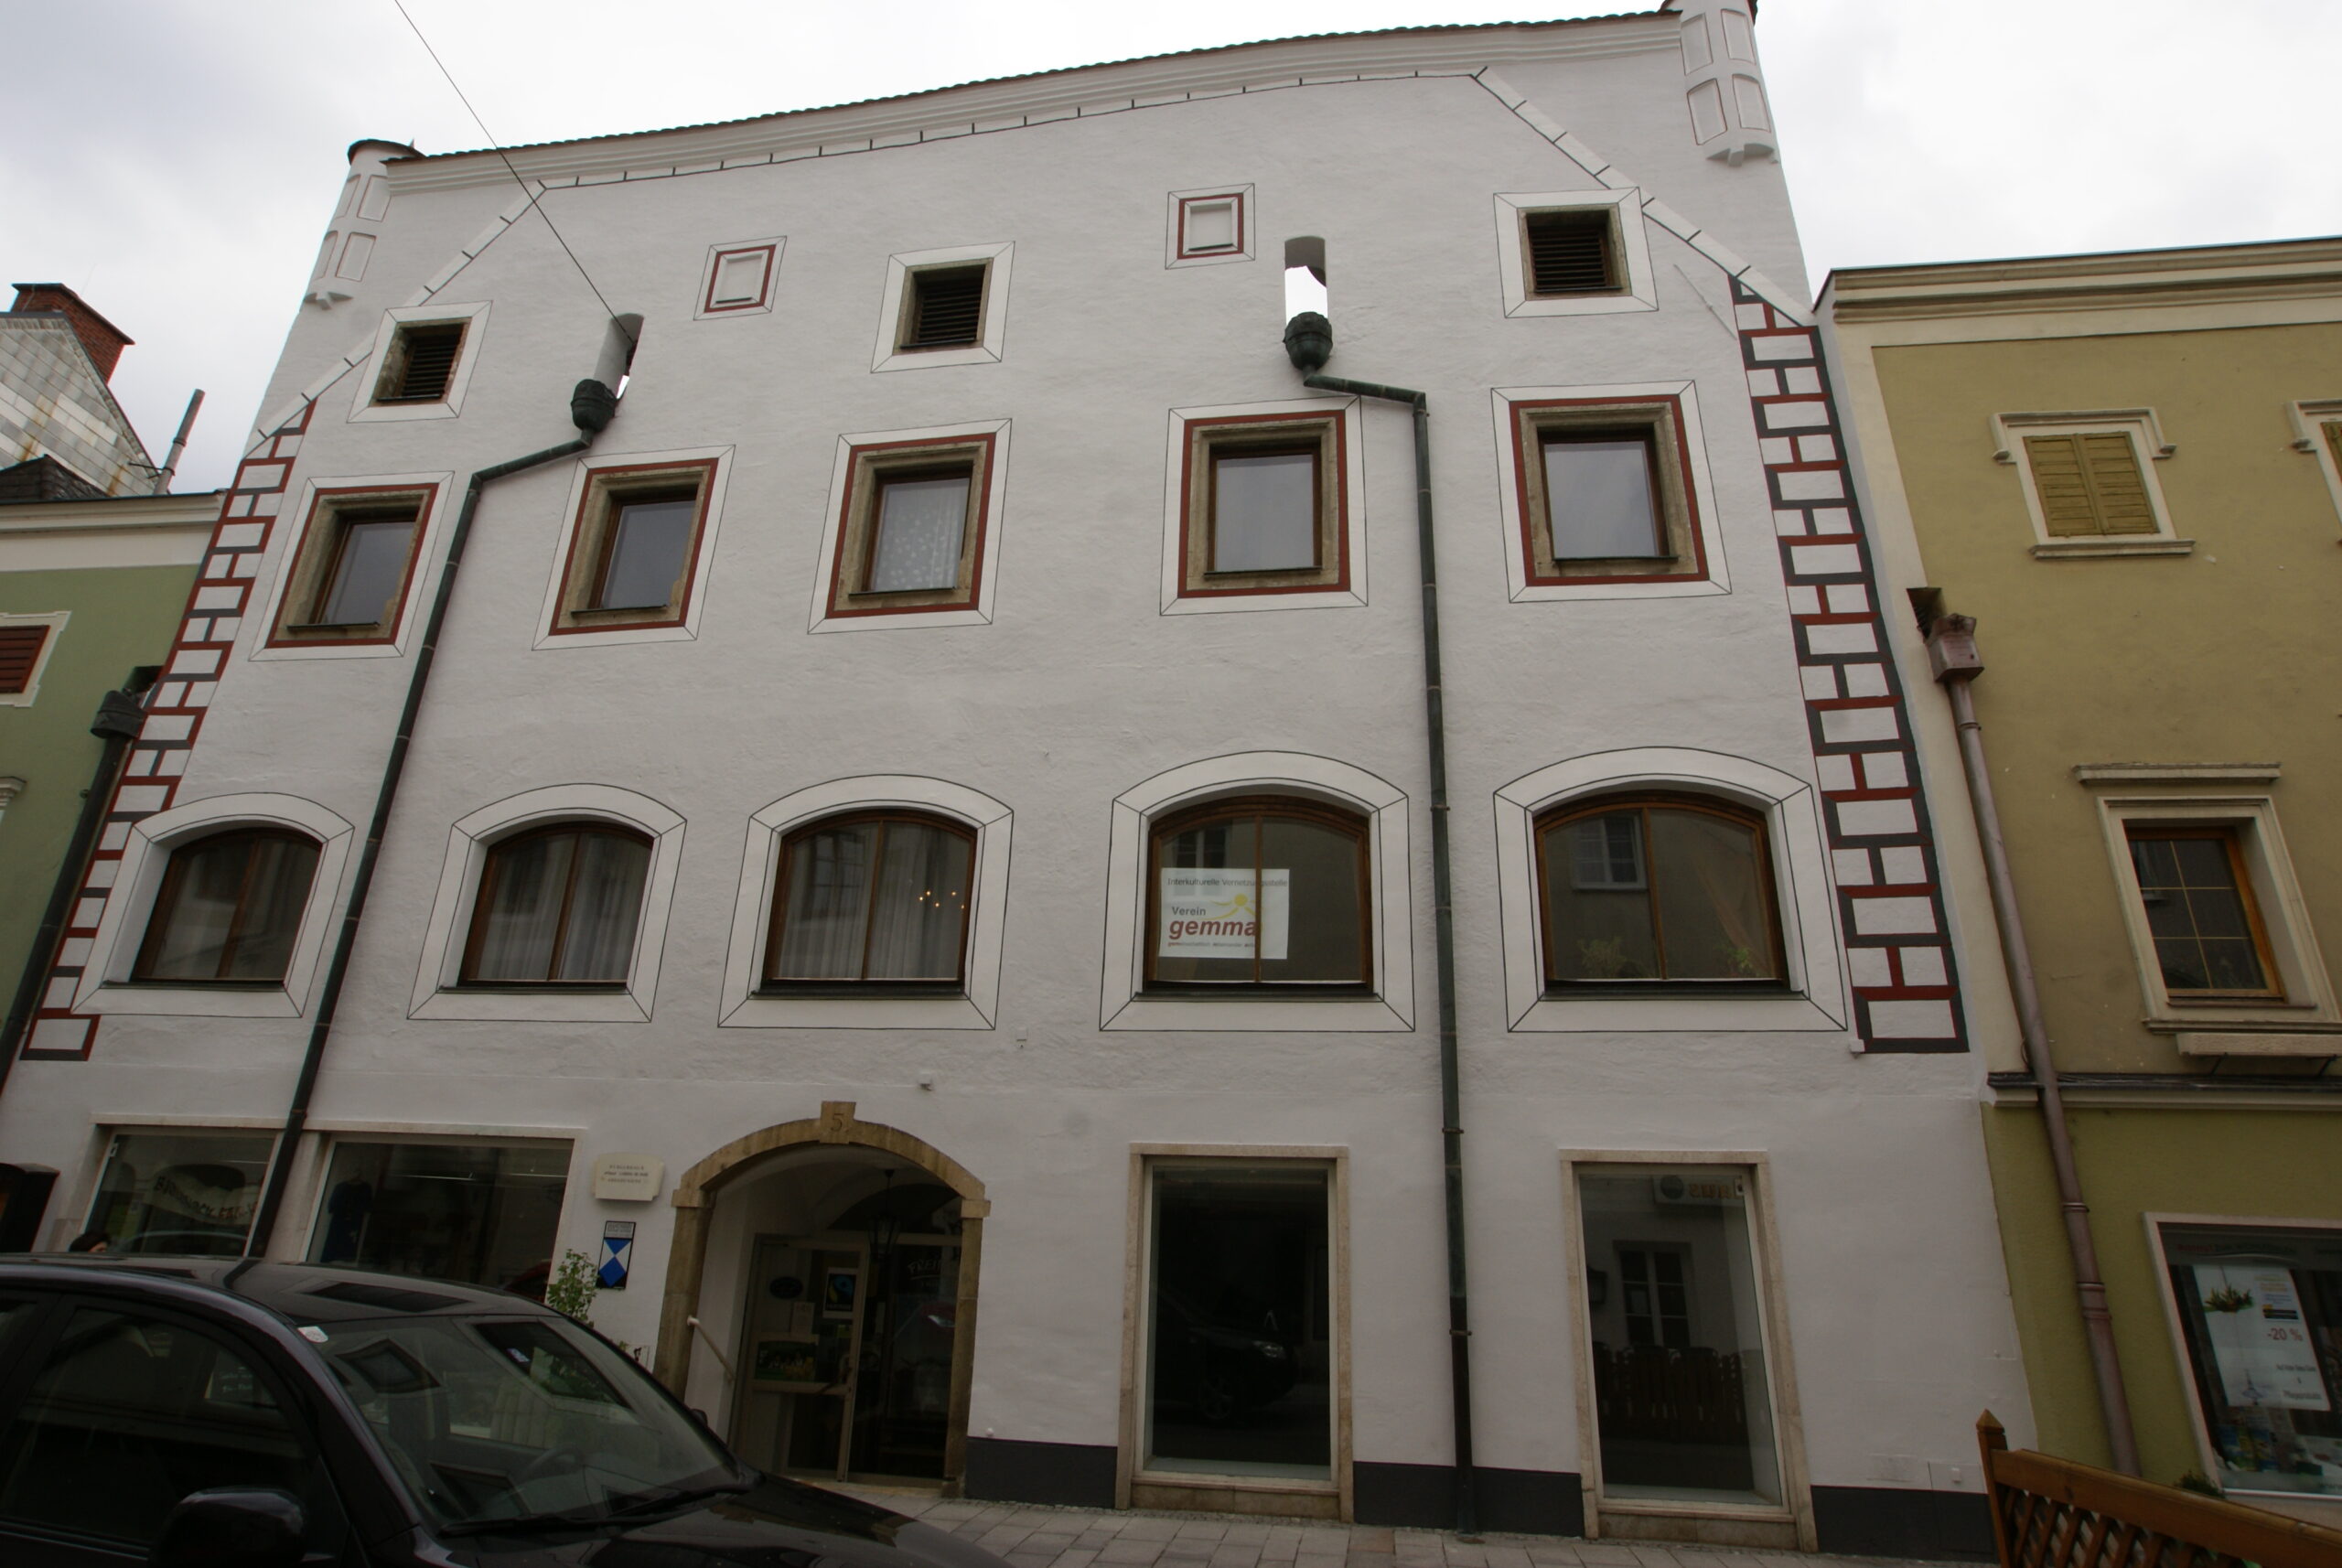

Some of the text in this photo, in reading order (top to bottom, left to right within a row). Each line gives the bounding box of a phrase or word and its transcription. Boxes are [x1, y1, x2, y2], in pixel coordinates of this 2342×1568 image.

[1167, 877, 1288, 887] Interkulturelle Vernetzusstelle
[1172, 906, 1206, 916] Verein
[1168, 919, 1256, 940] gemma
[830, 1112, 844, 1132] 5
[2267, 1327, 2304, 1342] -20 %
